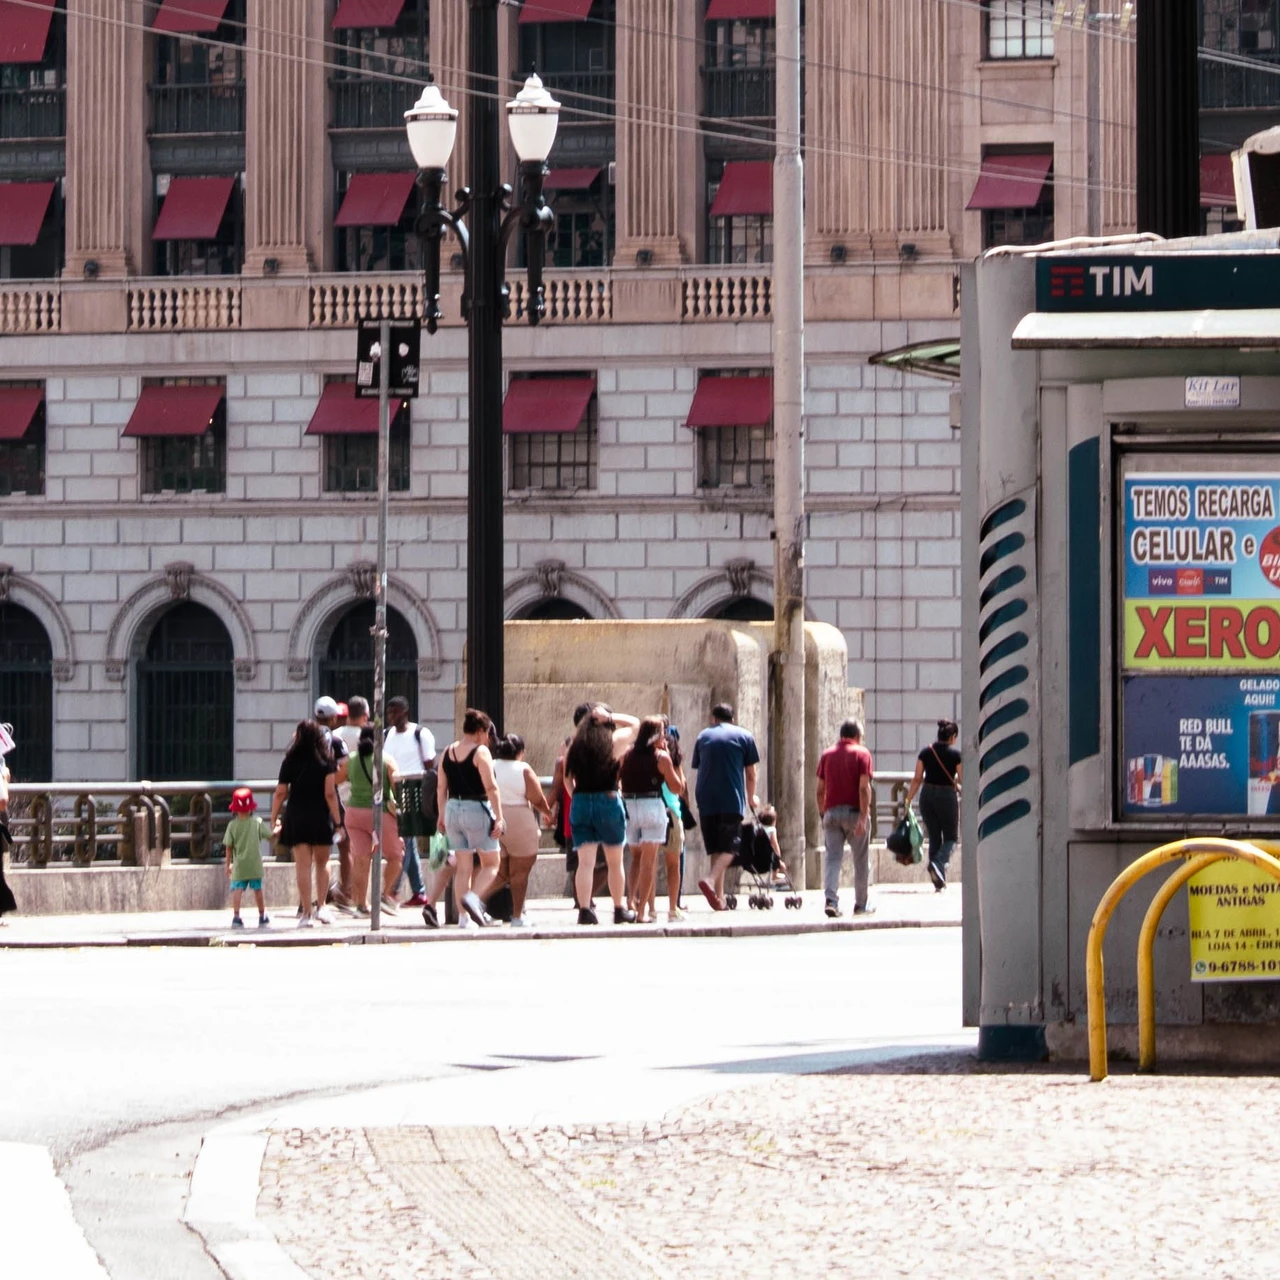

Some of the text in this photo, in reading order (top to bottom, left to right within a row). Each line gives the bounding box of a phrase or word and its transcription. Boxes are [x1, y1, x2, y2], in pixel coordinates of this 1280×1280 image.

[1089, 265, 1153, 297] TIM
[1188, 380, 1208, 391] Kit
[1132, 487, 1190, 518] TEMOS
[1197, 488, 1273, 518] RECARGA
[1133, 528, 1255, 562] CELULAR e
[1152, 575, 1173, 586] vivo
[1214, 576, 1228, 585] TIM
[1240, 679, 1280, 691] GELADO
[1244, 694, 1276, 706] AQUI!!!
[1179, 719, 1233, 734] RED BULL
[1179, 736, 1192, 751] TE
[1179, 753, 1230, 769] AAASAS.
[1190, 884, 1238, 896] MOEDAS
[1242, 886, 1249, 895] e
[1217, 896, 1265, 907] ANTIGAS
[1192, 930, 1211, 939] RUA
[1214, 929, 1220, 938] 7
[1224, 929, 1235, 938] DE
[1208, 941, 1231, 951] LOJA
[1236, 941, 1246, 950] 14
